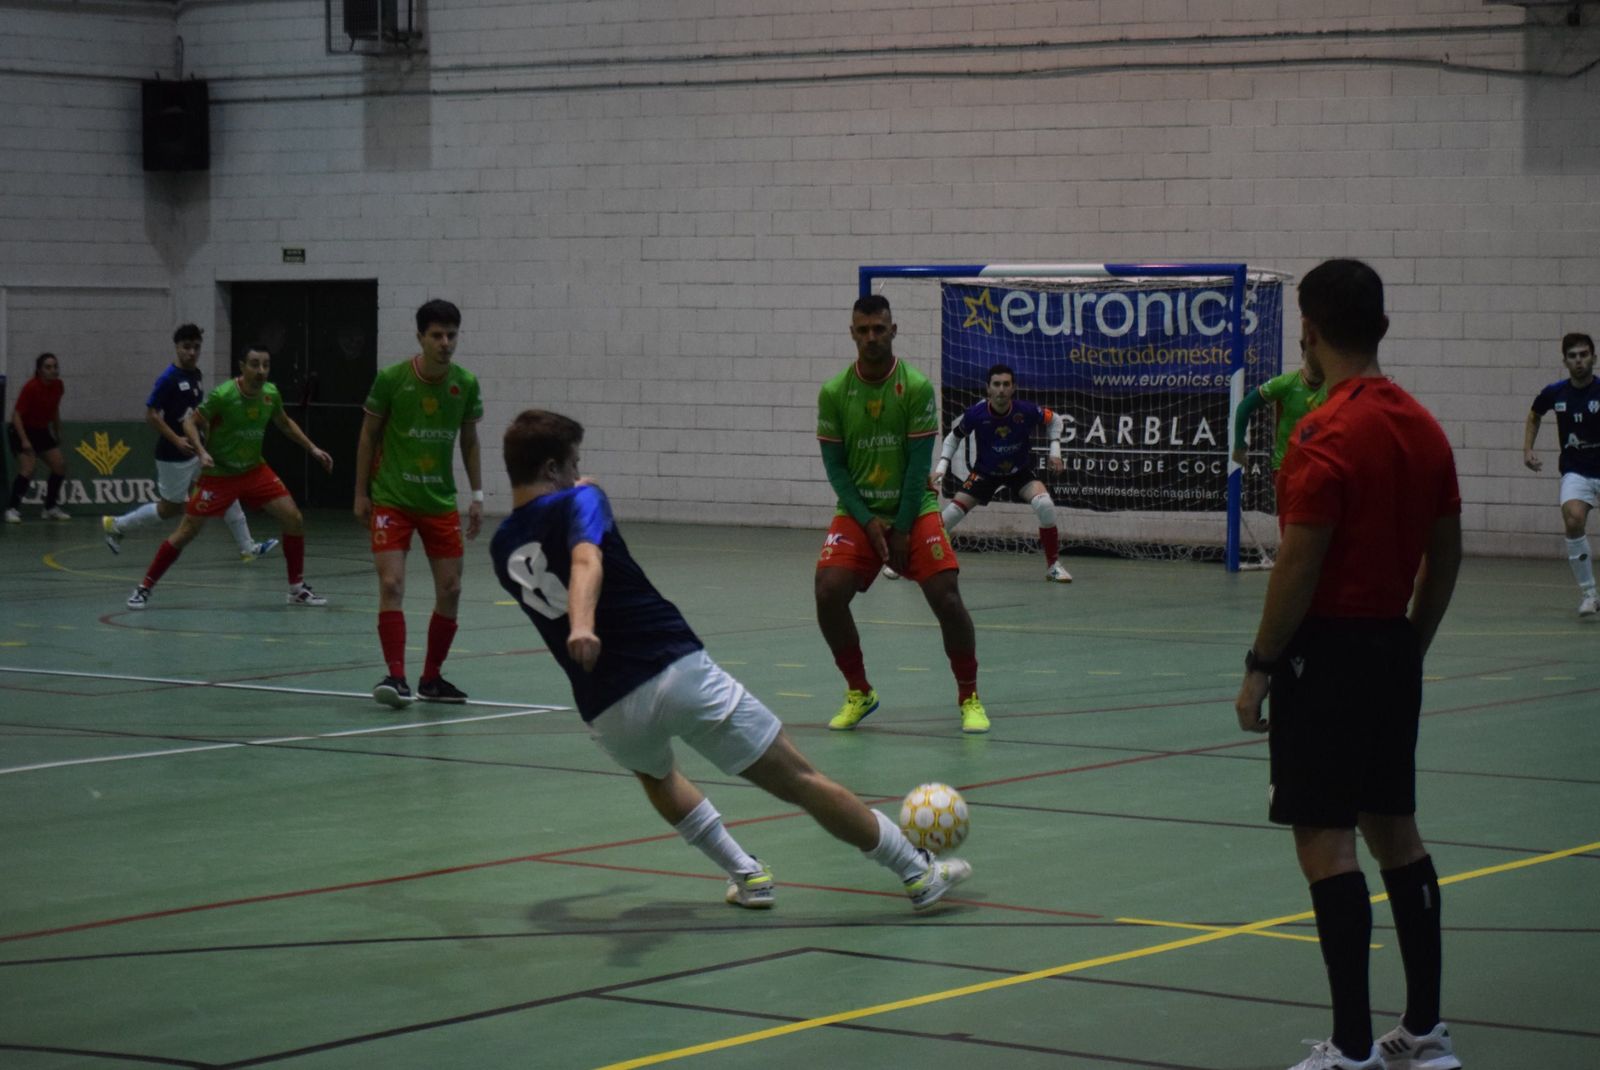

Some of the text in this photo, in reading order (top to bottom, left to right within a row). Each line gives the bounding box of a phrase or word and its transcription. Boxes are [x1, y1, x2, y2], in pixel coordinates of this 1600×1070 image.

[1070, 343, 1257, 367] electrodoméstics
[1093, 371, 1232, 388] www.euronics.es
[1060, 414, 1251, 446] GARBLA
[1039, 457, 1261, 475] ETUDIOS DE COCA
[92, 479, 190, 504] RUR
